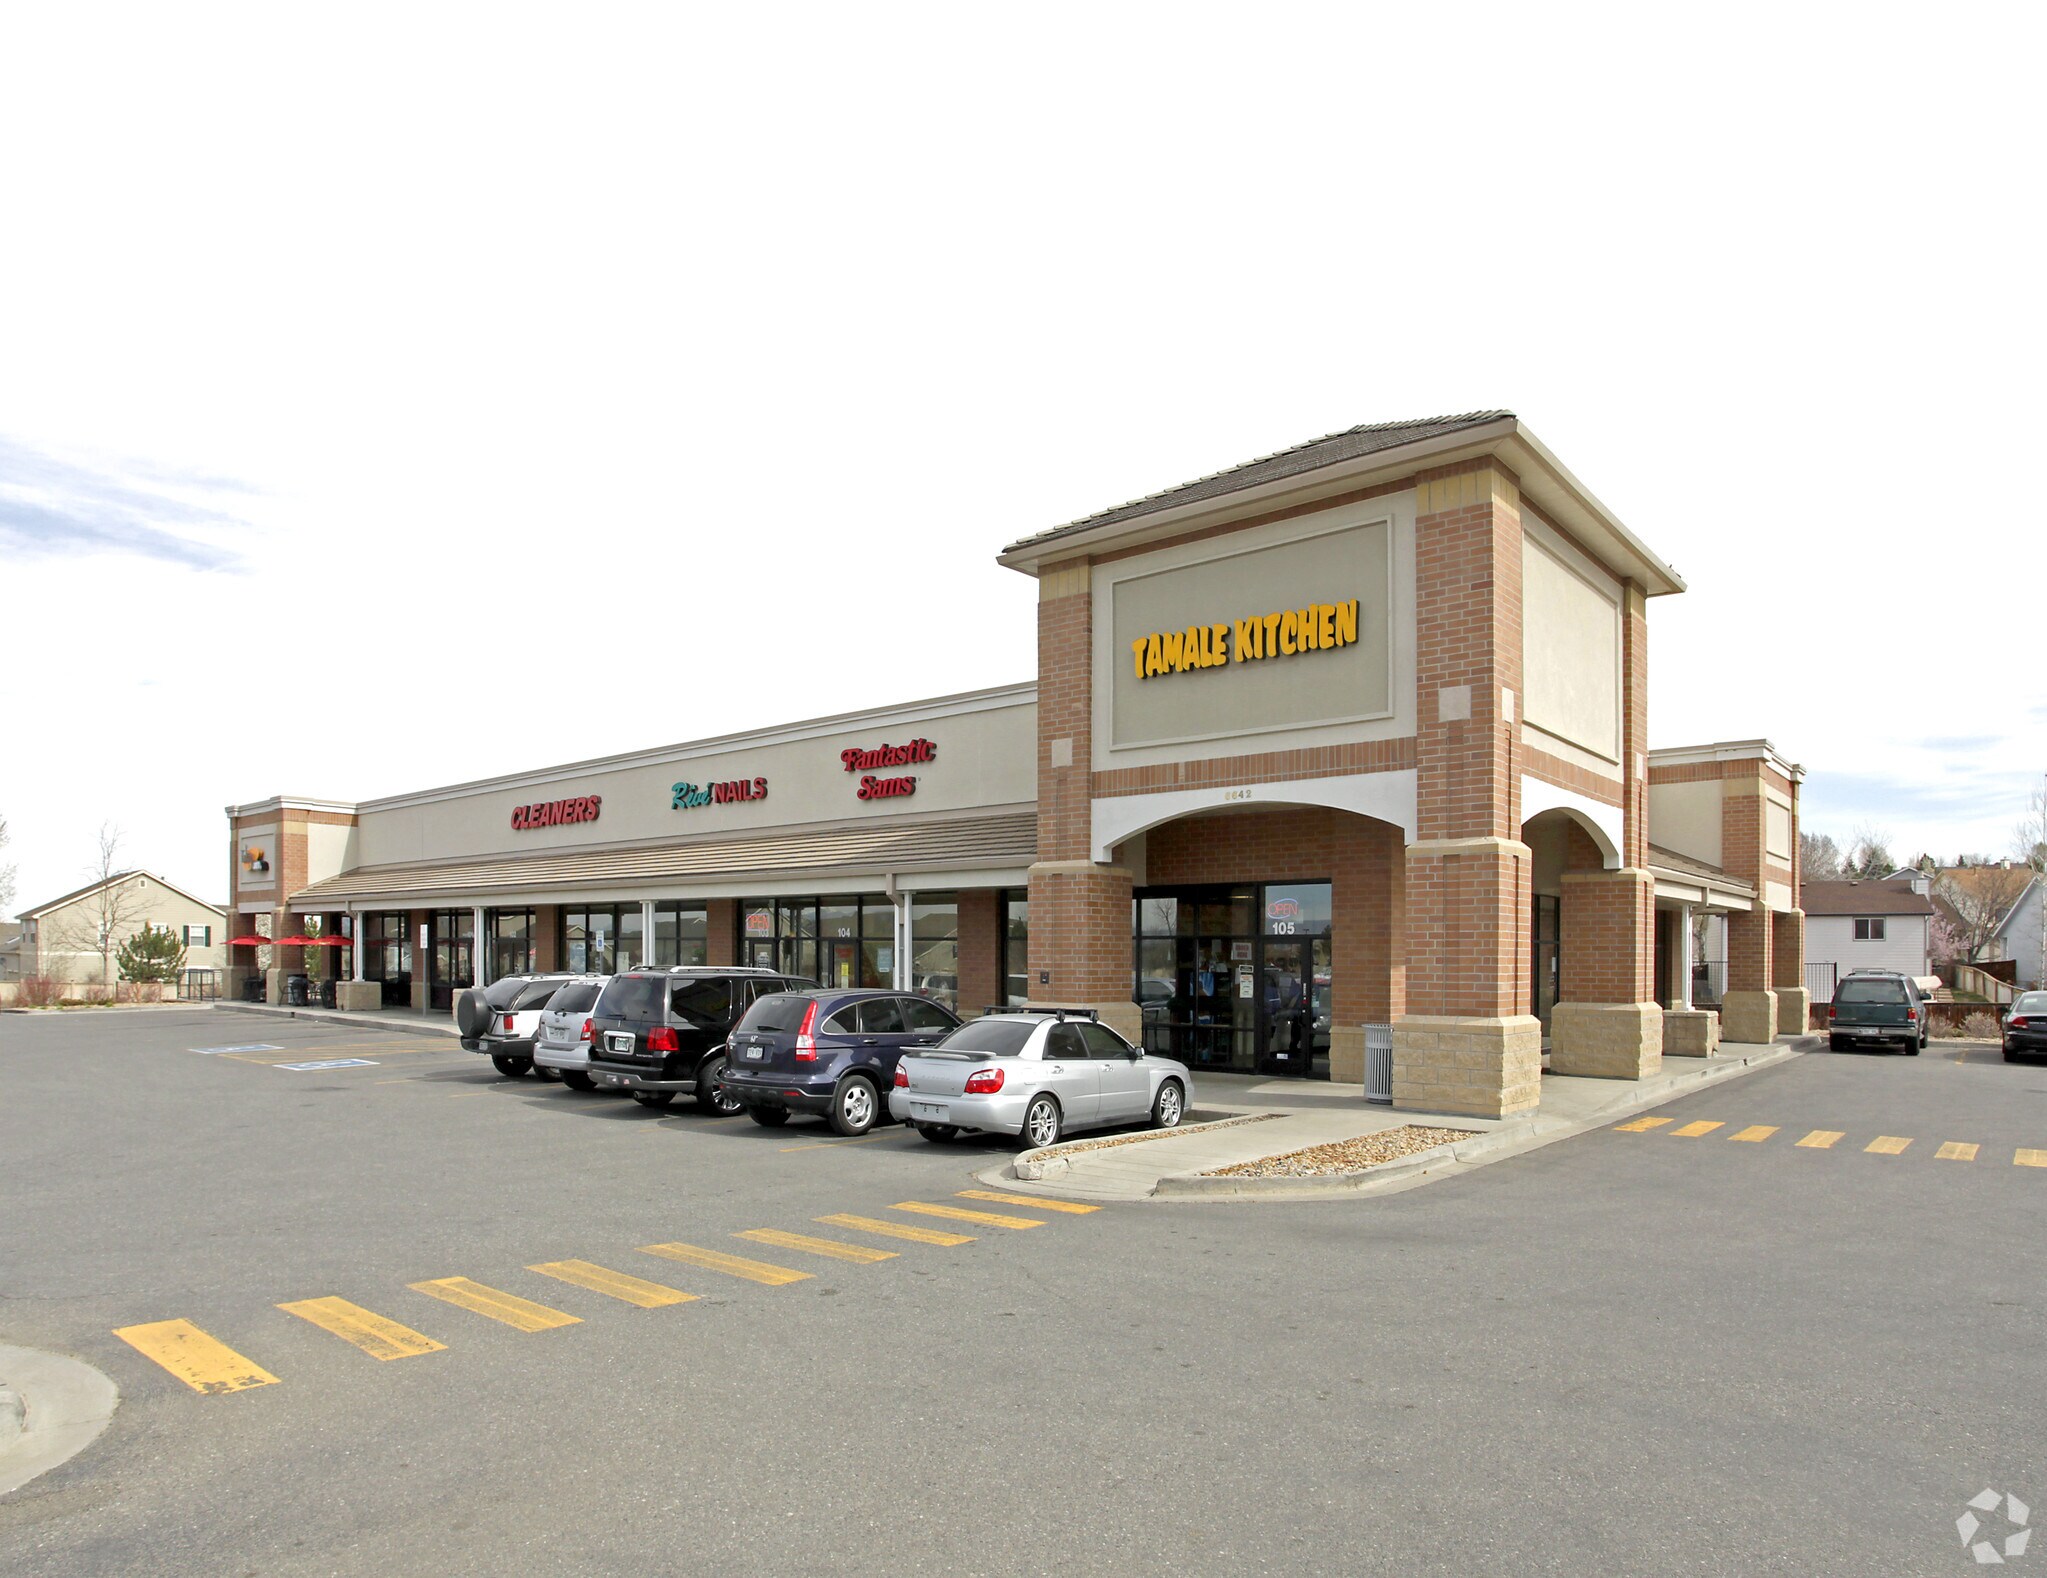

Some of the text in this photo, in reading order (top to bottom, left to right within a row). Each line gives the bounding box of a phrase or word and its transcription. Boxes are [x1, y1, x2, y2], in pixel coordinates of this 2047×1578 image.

[1132, 599, 1359, 679] TAMALE KITCHEN
[841, 739, 936, 771] Fantastic
[714, 777, 768, 802] NAILS
[857, 776, 916, 800] Sams
[511, 795, 601, 829] CLEANERS
[1268, 903, 1298, 916] OPEN
[747, 915, 769, 930] OPEN
[838, 927, 851, 938] 104
[1273, 922, 1295, 935] 105
